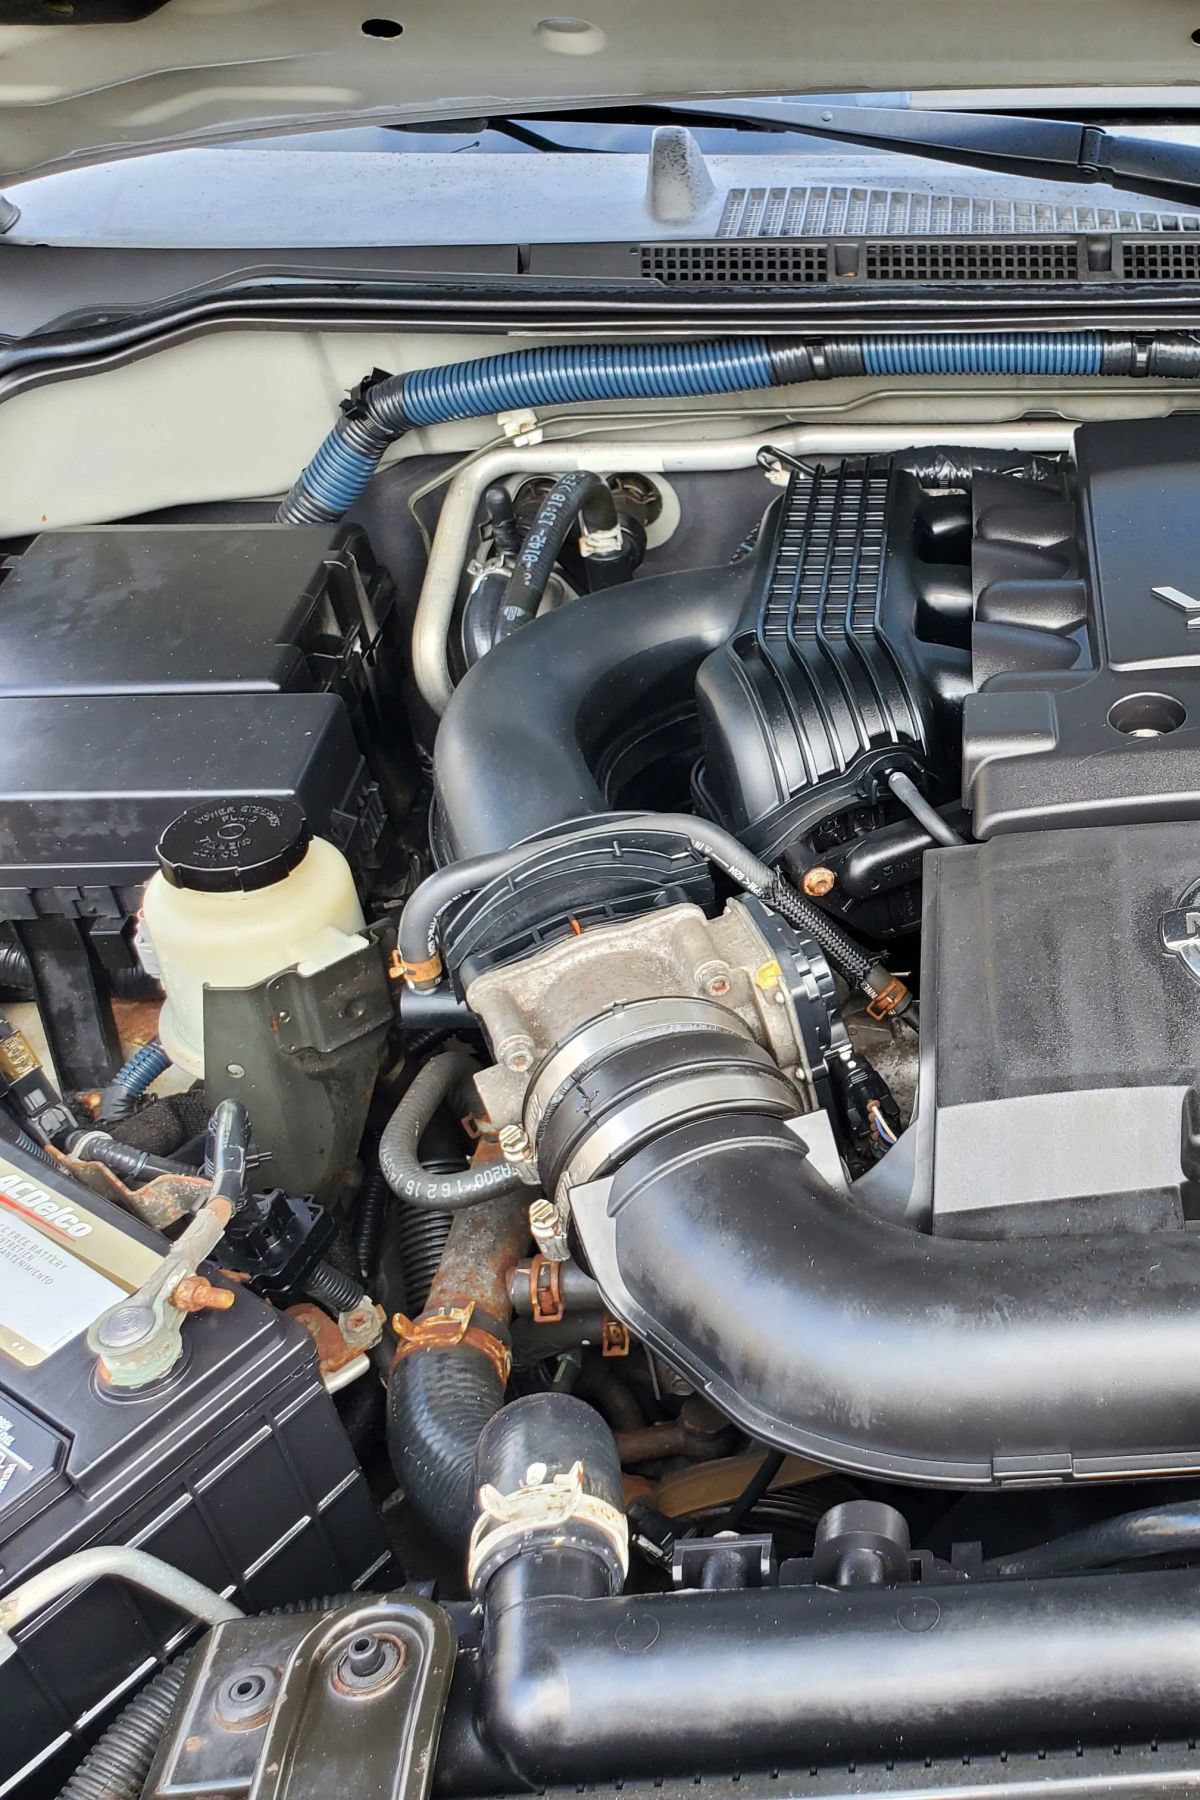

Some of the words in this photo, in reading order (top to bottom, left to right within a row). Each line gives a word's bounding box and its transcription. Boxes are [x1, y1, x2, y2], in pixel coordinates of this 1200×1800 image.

[194, 806, 235, 824] POWER
[240, 805, 281, 827] STEERING
[221, 815, 257, 823] FLUID
[0, 1174, 94, 1237] ACDelco
[9, 1230, 31, 1247] FREE
[29, 1243, 70, 1271] BATTERY
